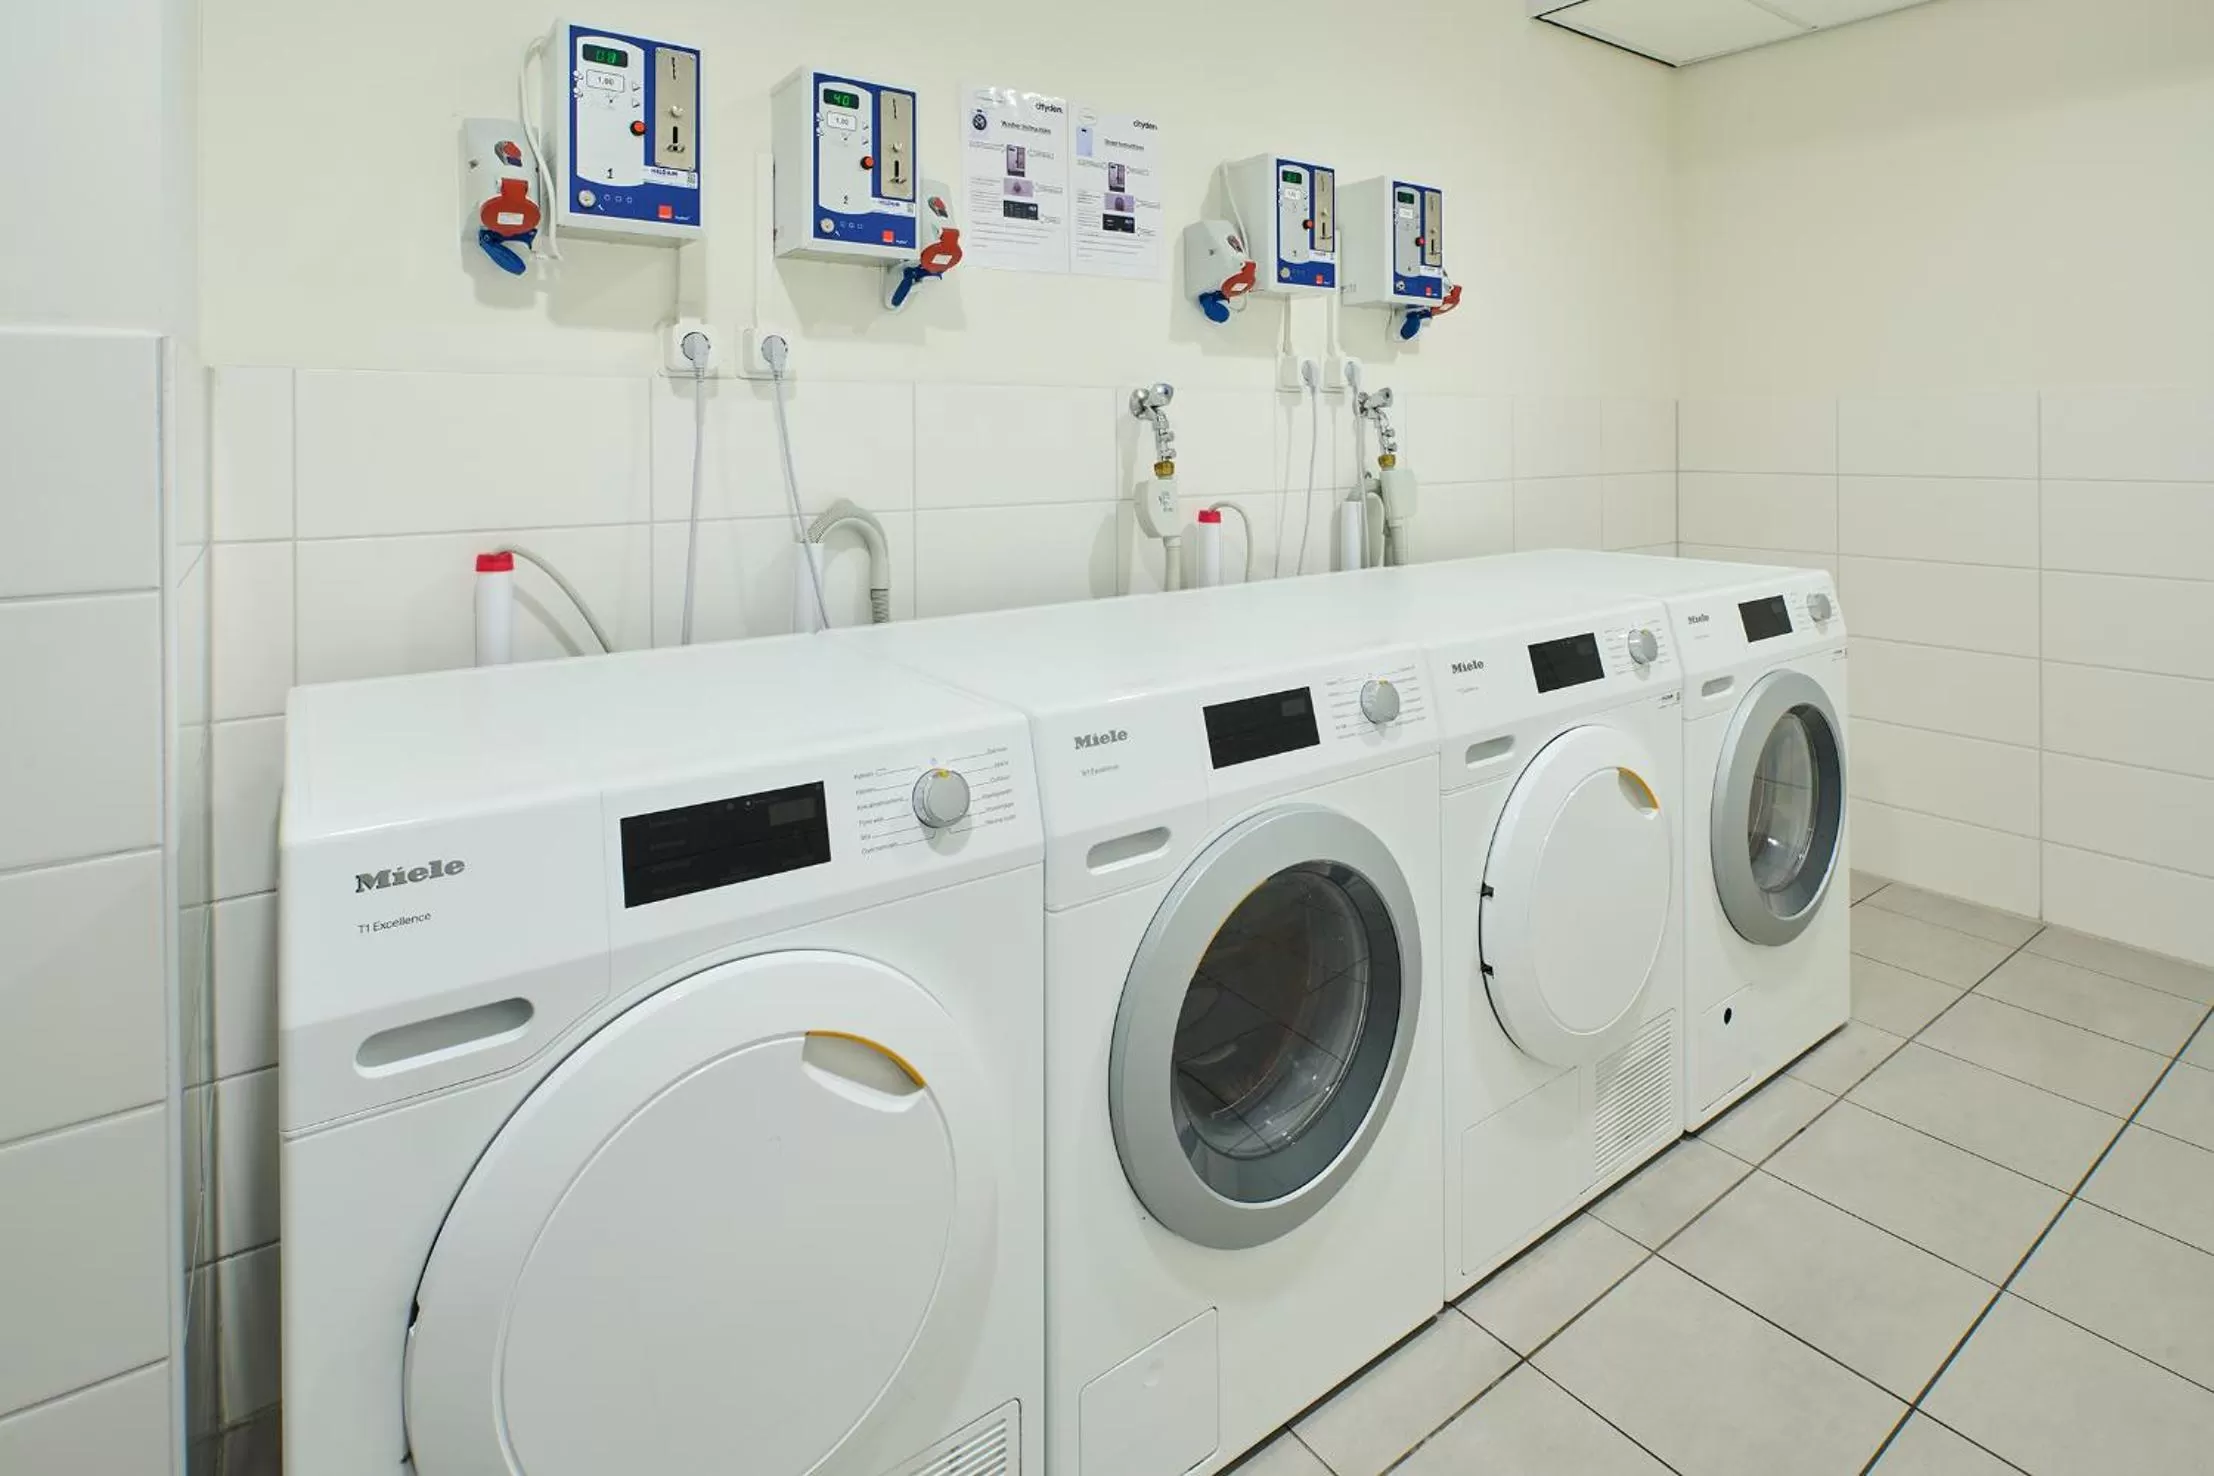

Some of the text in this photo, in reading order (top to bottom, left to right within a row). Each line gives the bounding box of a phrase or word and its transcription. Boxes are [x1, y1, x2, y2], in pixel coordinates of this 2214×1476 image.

[607, 168, 614, 179] 1
[1451, 660, 1484, 674] Miele
[1073, 729, 1128, 750] Miele
[355, 859, 466, 894] Miele
[357, 912, 432, 935] T1 Excellence
